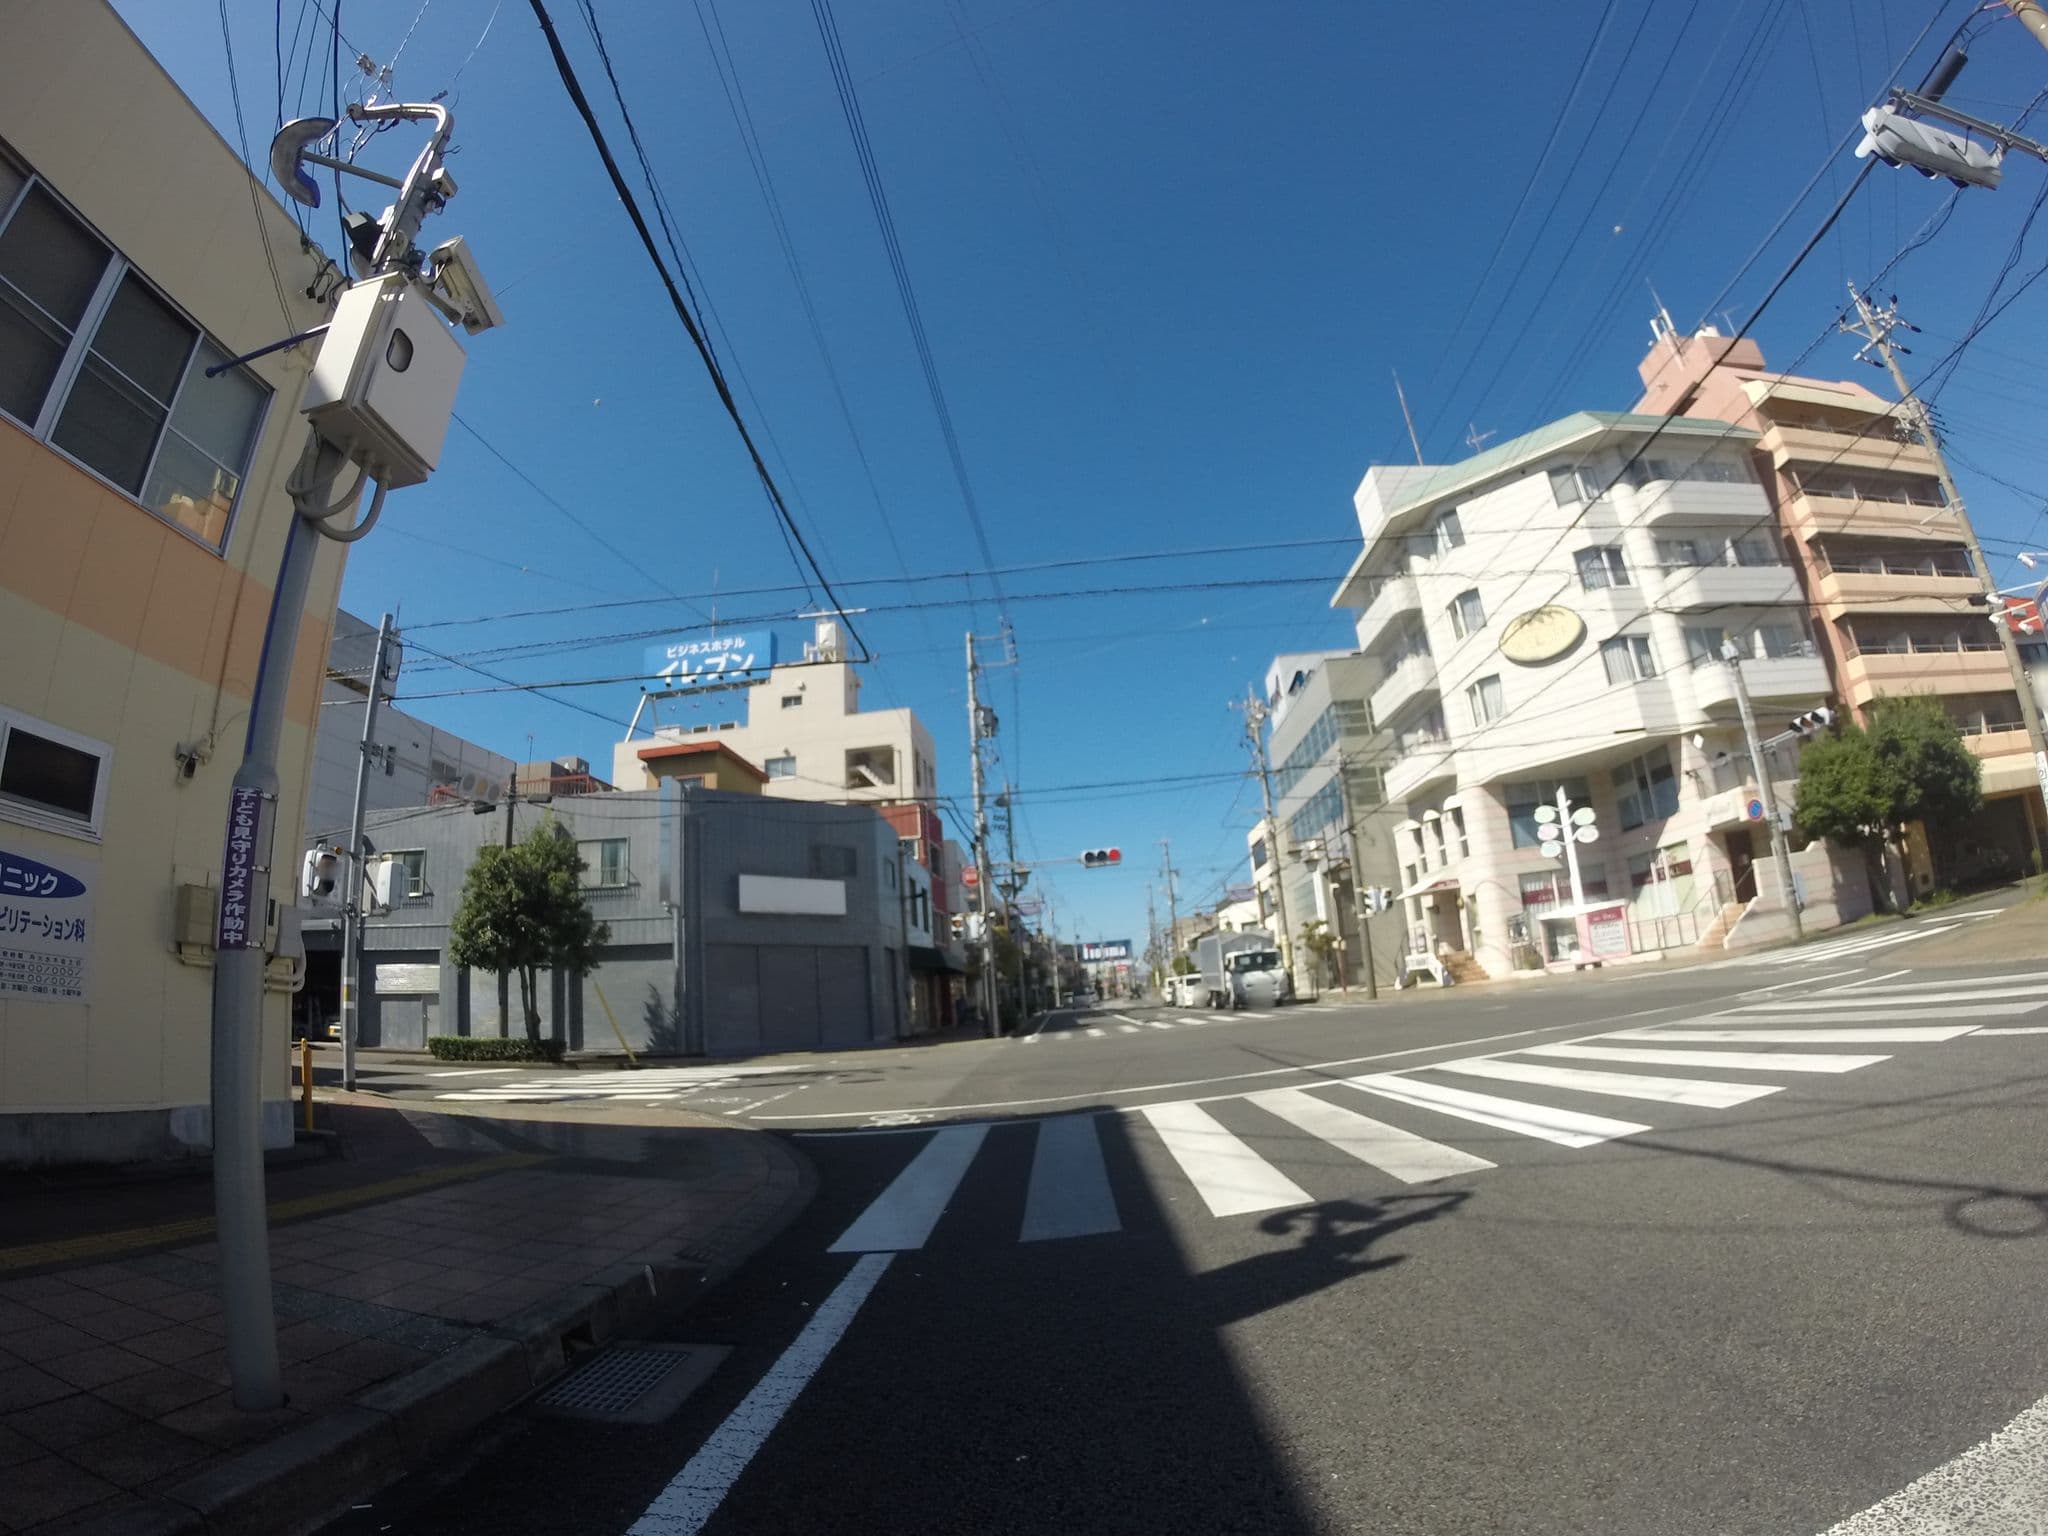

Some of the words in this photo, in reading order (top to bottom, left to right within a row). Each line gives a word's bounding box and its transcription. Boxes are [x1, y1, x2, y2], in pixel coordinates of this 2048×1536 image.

[668, 638, 745, 657] ビジネスホテル
[656, 653, 755, 684] イレブン
[223, 787, 258, 945] 子ども見守りカメラ作動中
